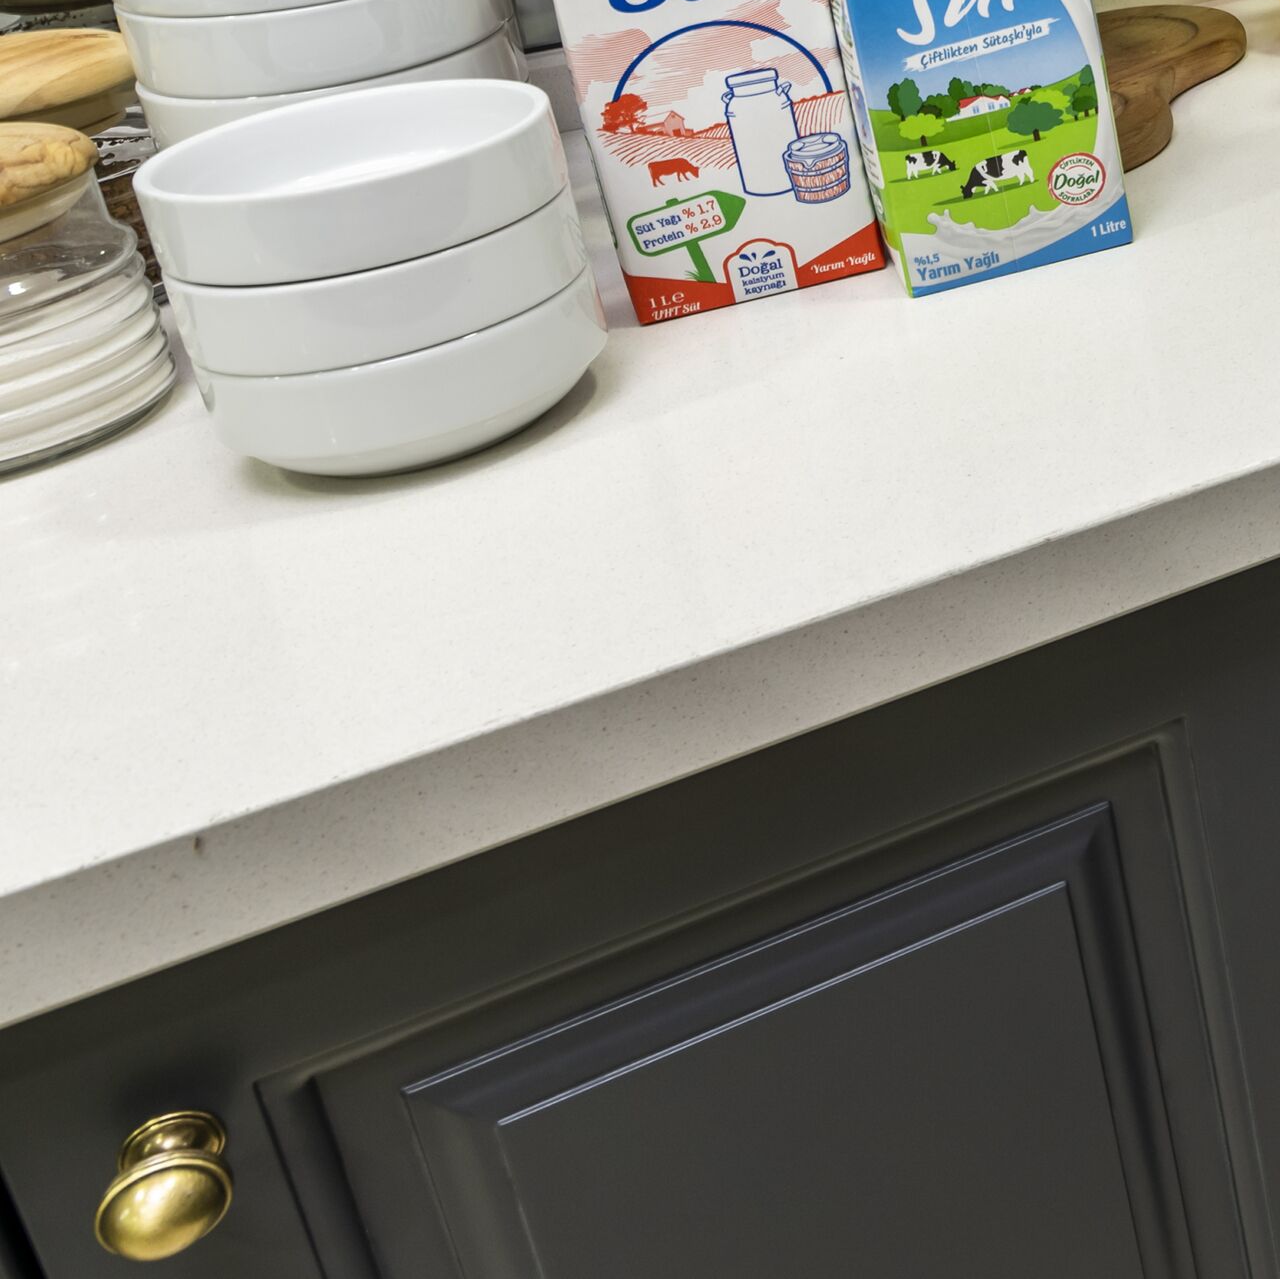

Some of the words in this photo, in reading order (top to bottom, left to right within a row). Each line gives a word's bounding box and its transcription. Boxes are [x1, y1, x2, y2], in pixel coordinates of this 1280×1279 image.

[920, 43, 978, 69] Çiftlikten
[982, 24, 1042, 49] Sütaşkı'yla
[1054, 169, 1100, 191] Doğal
[1058, 188, 1095, 202] SOFRALARA
[635, 222, 656, 236] Süt
[656, 214, 682, 228] Yağı
[682, 208, 696, 219] %
[698, 200, 717, 216] 1.7
[1091, 225, 1098, 237] 1
[1100, 219, 1127, 236] Litre
[643, 230, 685, 250] Protein
[685, 223, 699, 235] %
[700, 214, 723, 231] 2.9
[739, 258, 783, 278] Doğal
[811, 260, 845, 275] Yarım
[846, 252, 876, 269] Yağlı
[914, 253, 940, 267] %1,5
[916, 263, 961, 281] Yarım
[964, 250, 1000, 270] Yağlı
[742, 271, 785, 287] kalsiyum
[744, 280, 787, 296] kaynağı
[650, 297, 658, 309] 1
[652, 306, 681, 321] UHT
[682, 301, 701, 314] Süt
